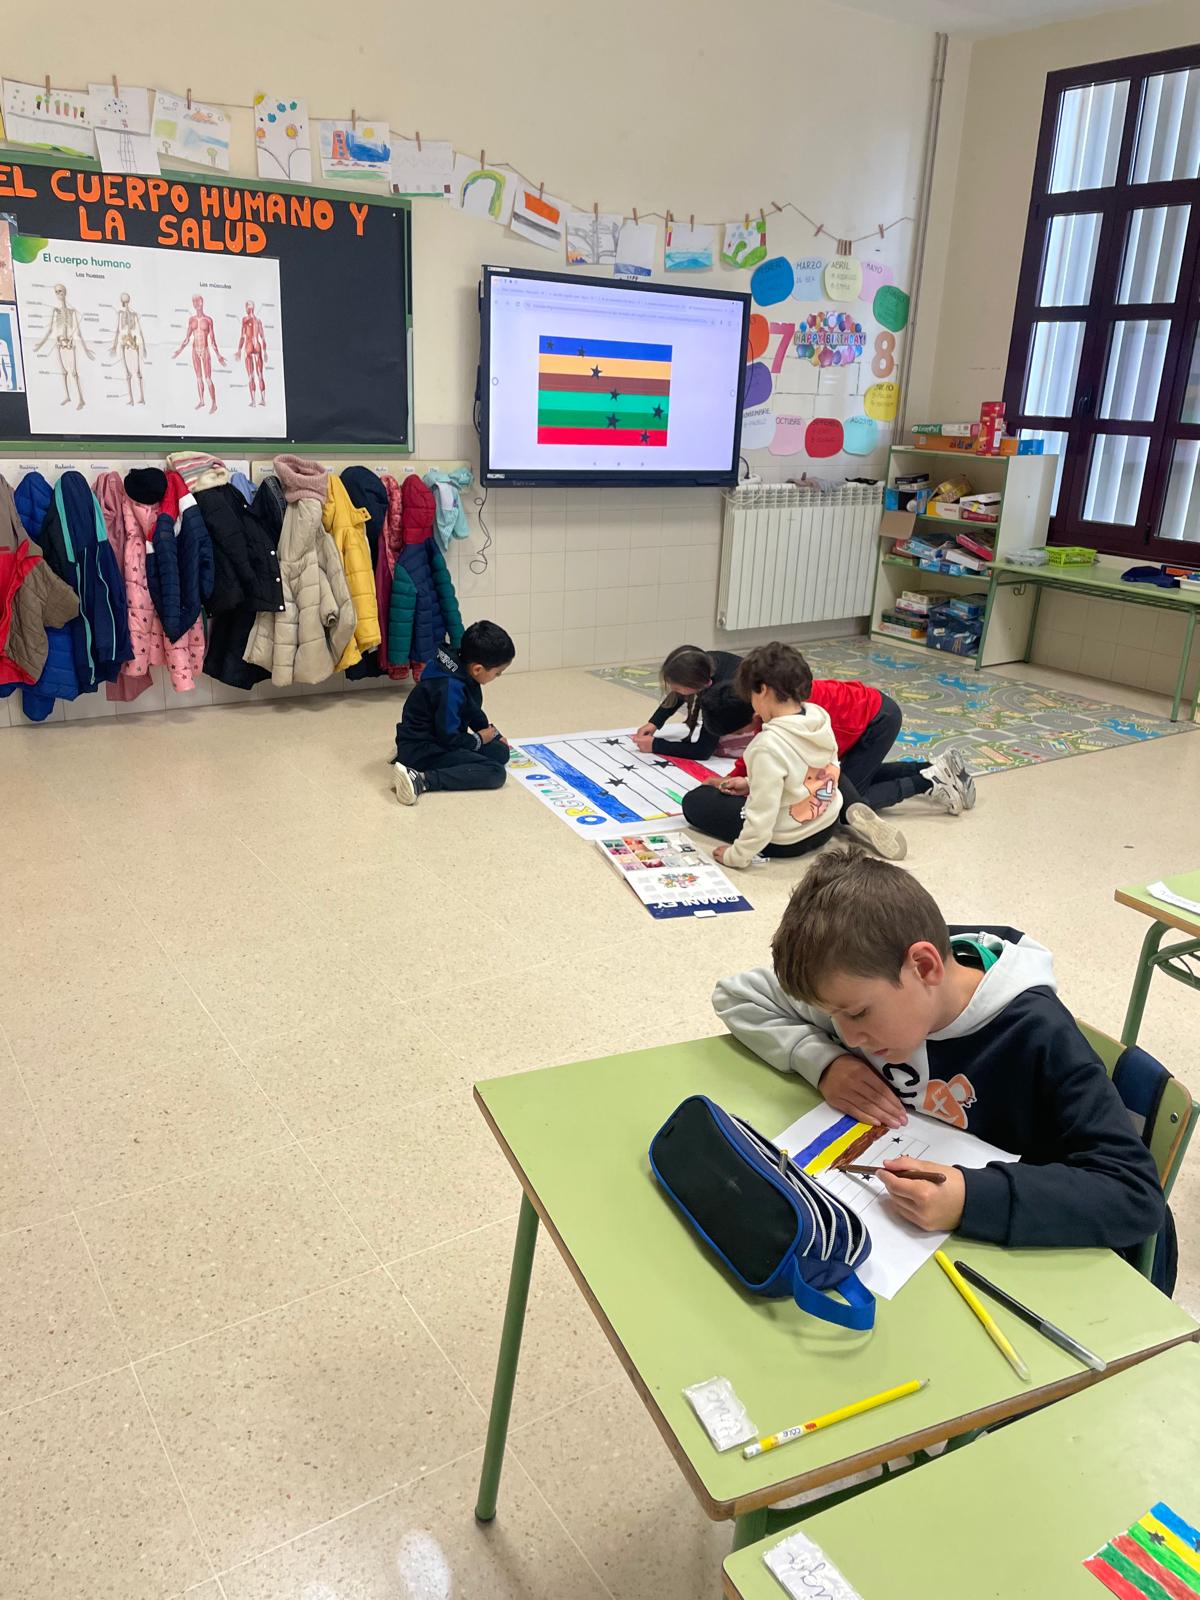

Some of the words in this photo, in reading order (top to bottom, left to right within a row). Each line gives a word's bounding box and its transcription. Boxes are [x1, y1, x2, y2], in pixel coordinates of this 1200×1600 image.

[0, 165, 38, 198] EL
[51, 169, 189, 213] CUERPO
[200, 186, 334, 230] HUMANO
[349, 202, 369, 236] Y
[79, 205, 126, 241] LA
[157, 214, 267, 254] SALUD
[43, 252, 51, 262] El
[54, 256, 88, 268] cuerpo
[91, 257, 131, 269] humano
[796, 260, 822, 270] MARZO
[831, 260, 850, 270] ABRIL
[866, 263, 883, 274] MAYO
[794, 332, 825, 345] HAPPY
[825, 332, 866, 345] BIRTHDAY!
[769, 322, 795, 374] 7
[871, 331, 896, 379] 8
[776, 416, 801, 425] OCTUBRE
[655, 896, 727, 909] MANLEY
